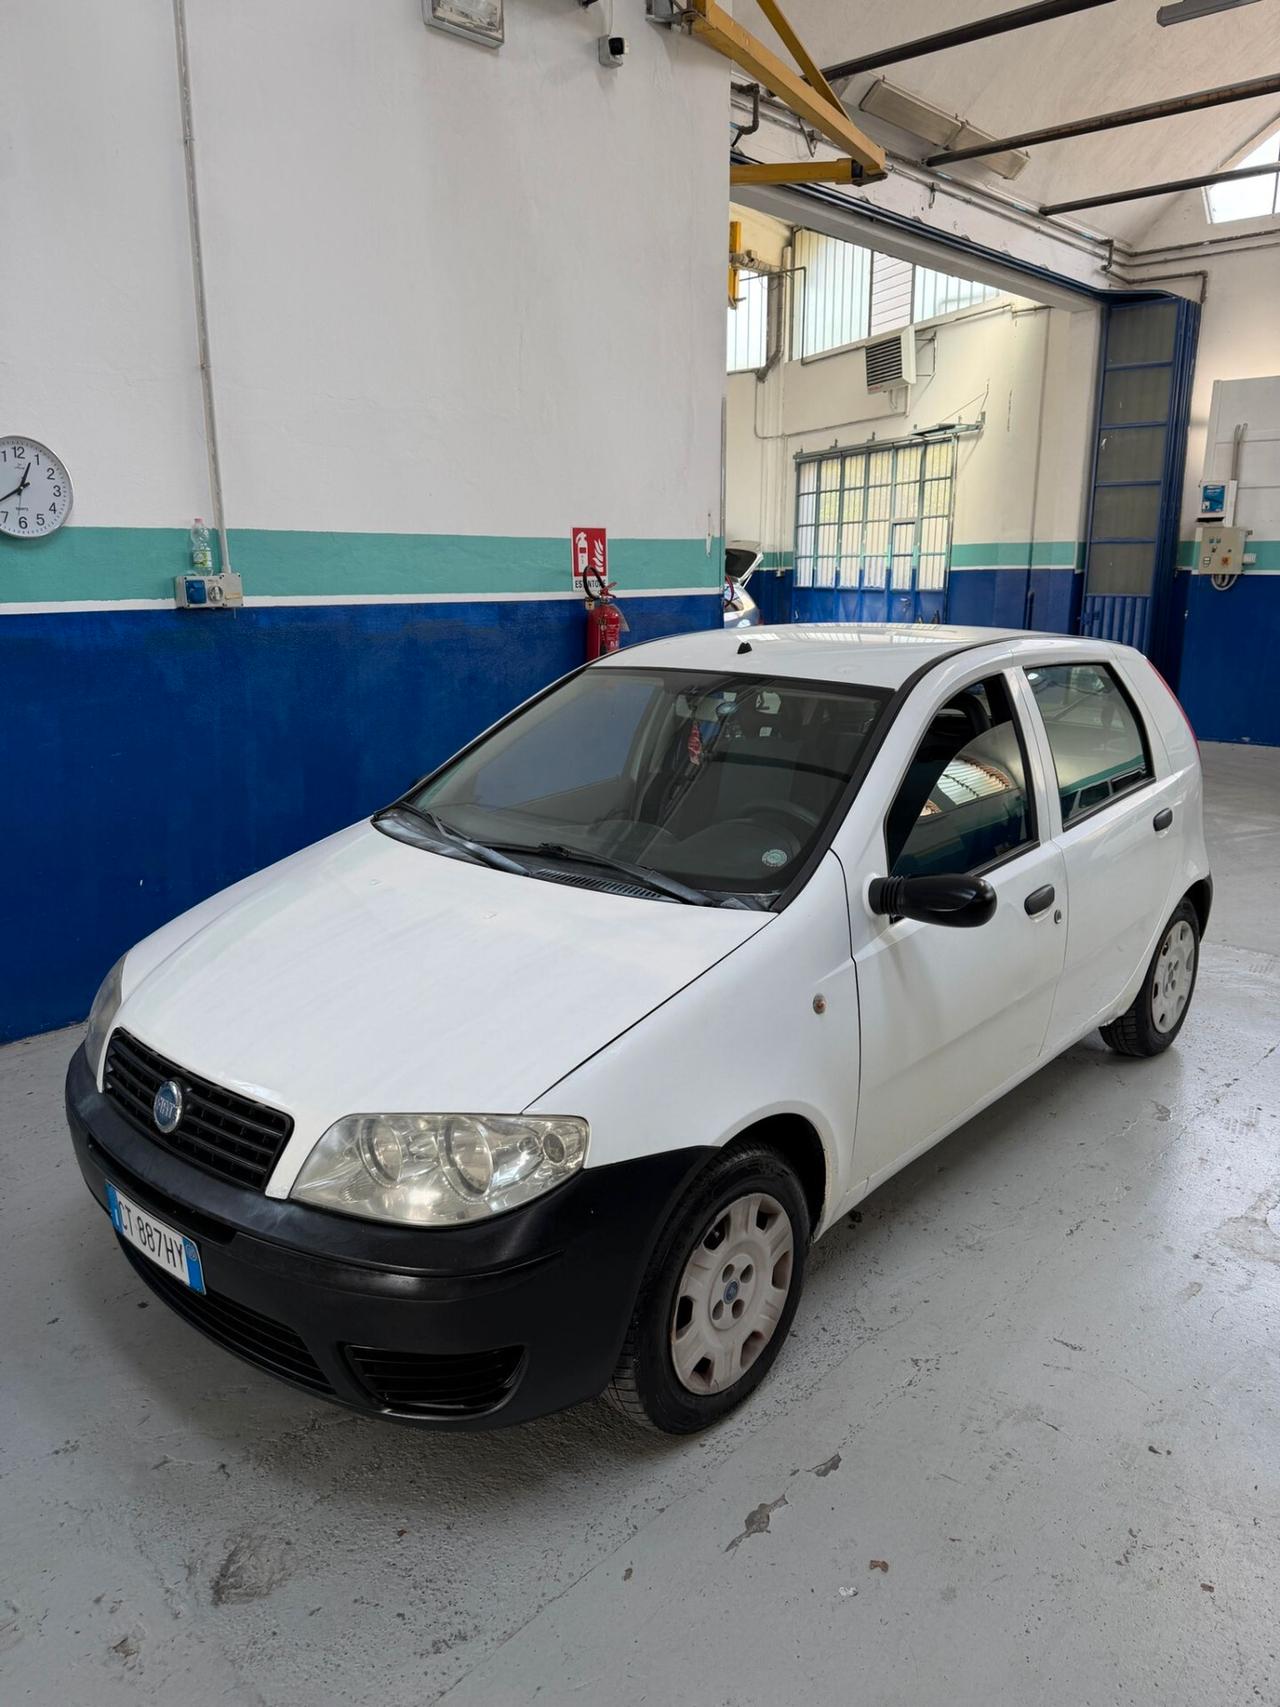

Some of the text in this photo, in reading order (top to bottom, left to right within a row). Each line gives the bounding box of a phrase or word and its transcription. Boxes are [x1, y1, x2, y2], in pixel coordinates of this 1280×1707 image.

[11, 446, 25, 459] 12
[34, 453, 40, 466] 1
[46, 467, 55, 480] 2
[53, 484, 62, 497] 3
[49, 502, 57, 514] 4
[0, 510, 9, 523] 7
[18, 516, 28, 529] 6
[36, 513, 45, 526] 5
[118, 1201, 133, 1236] CT
